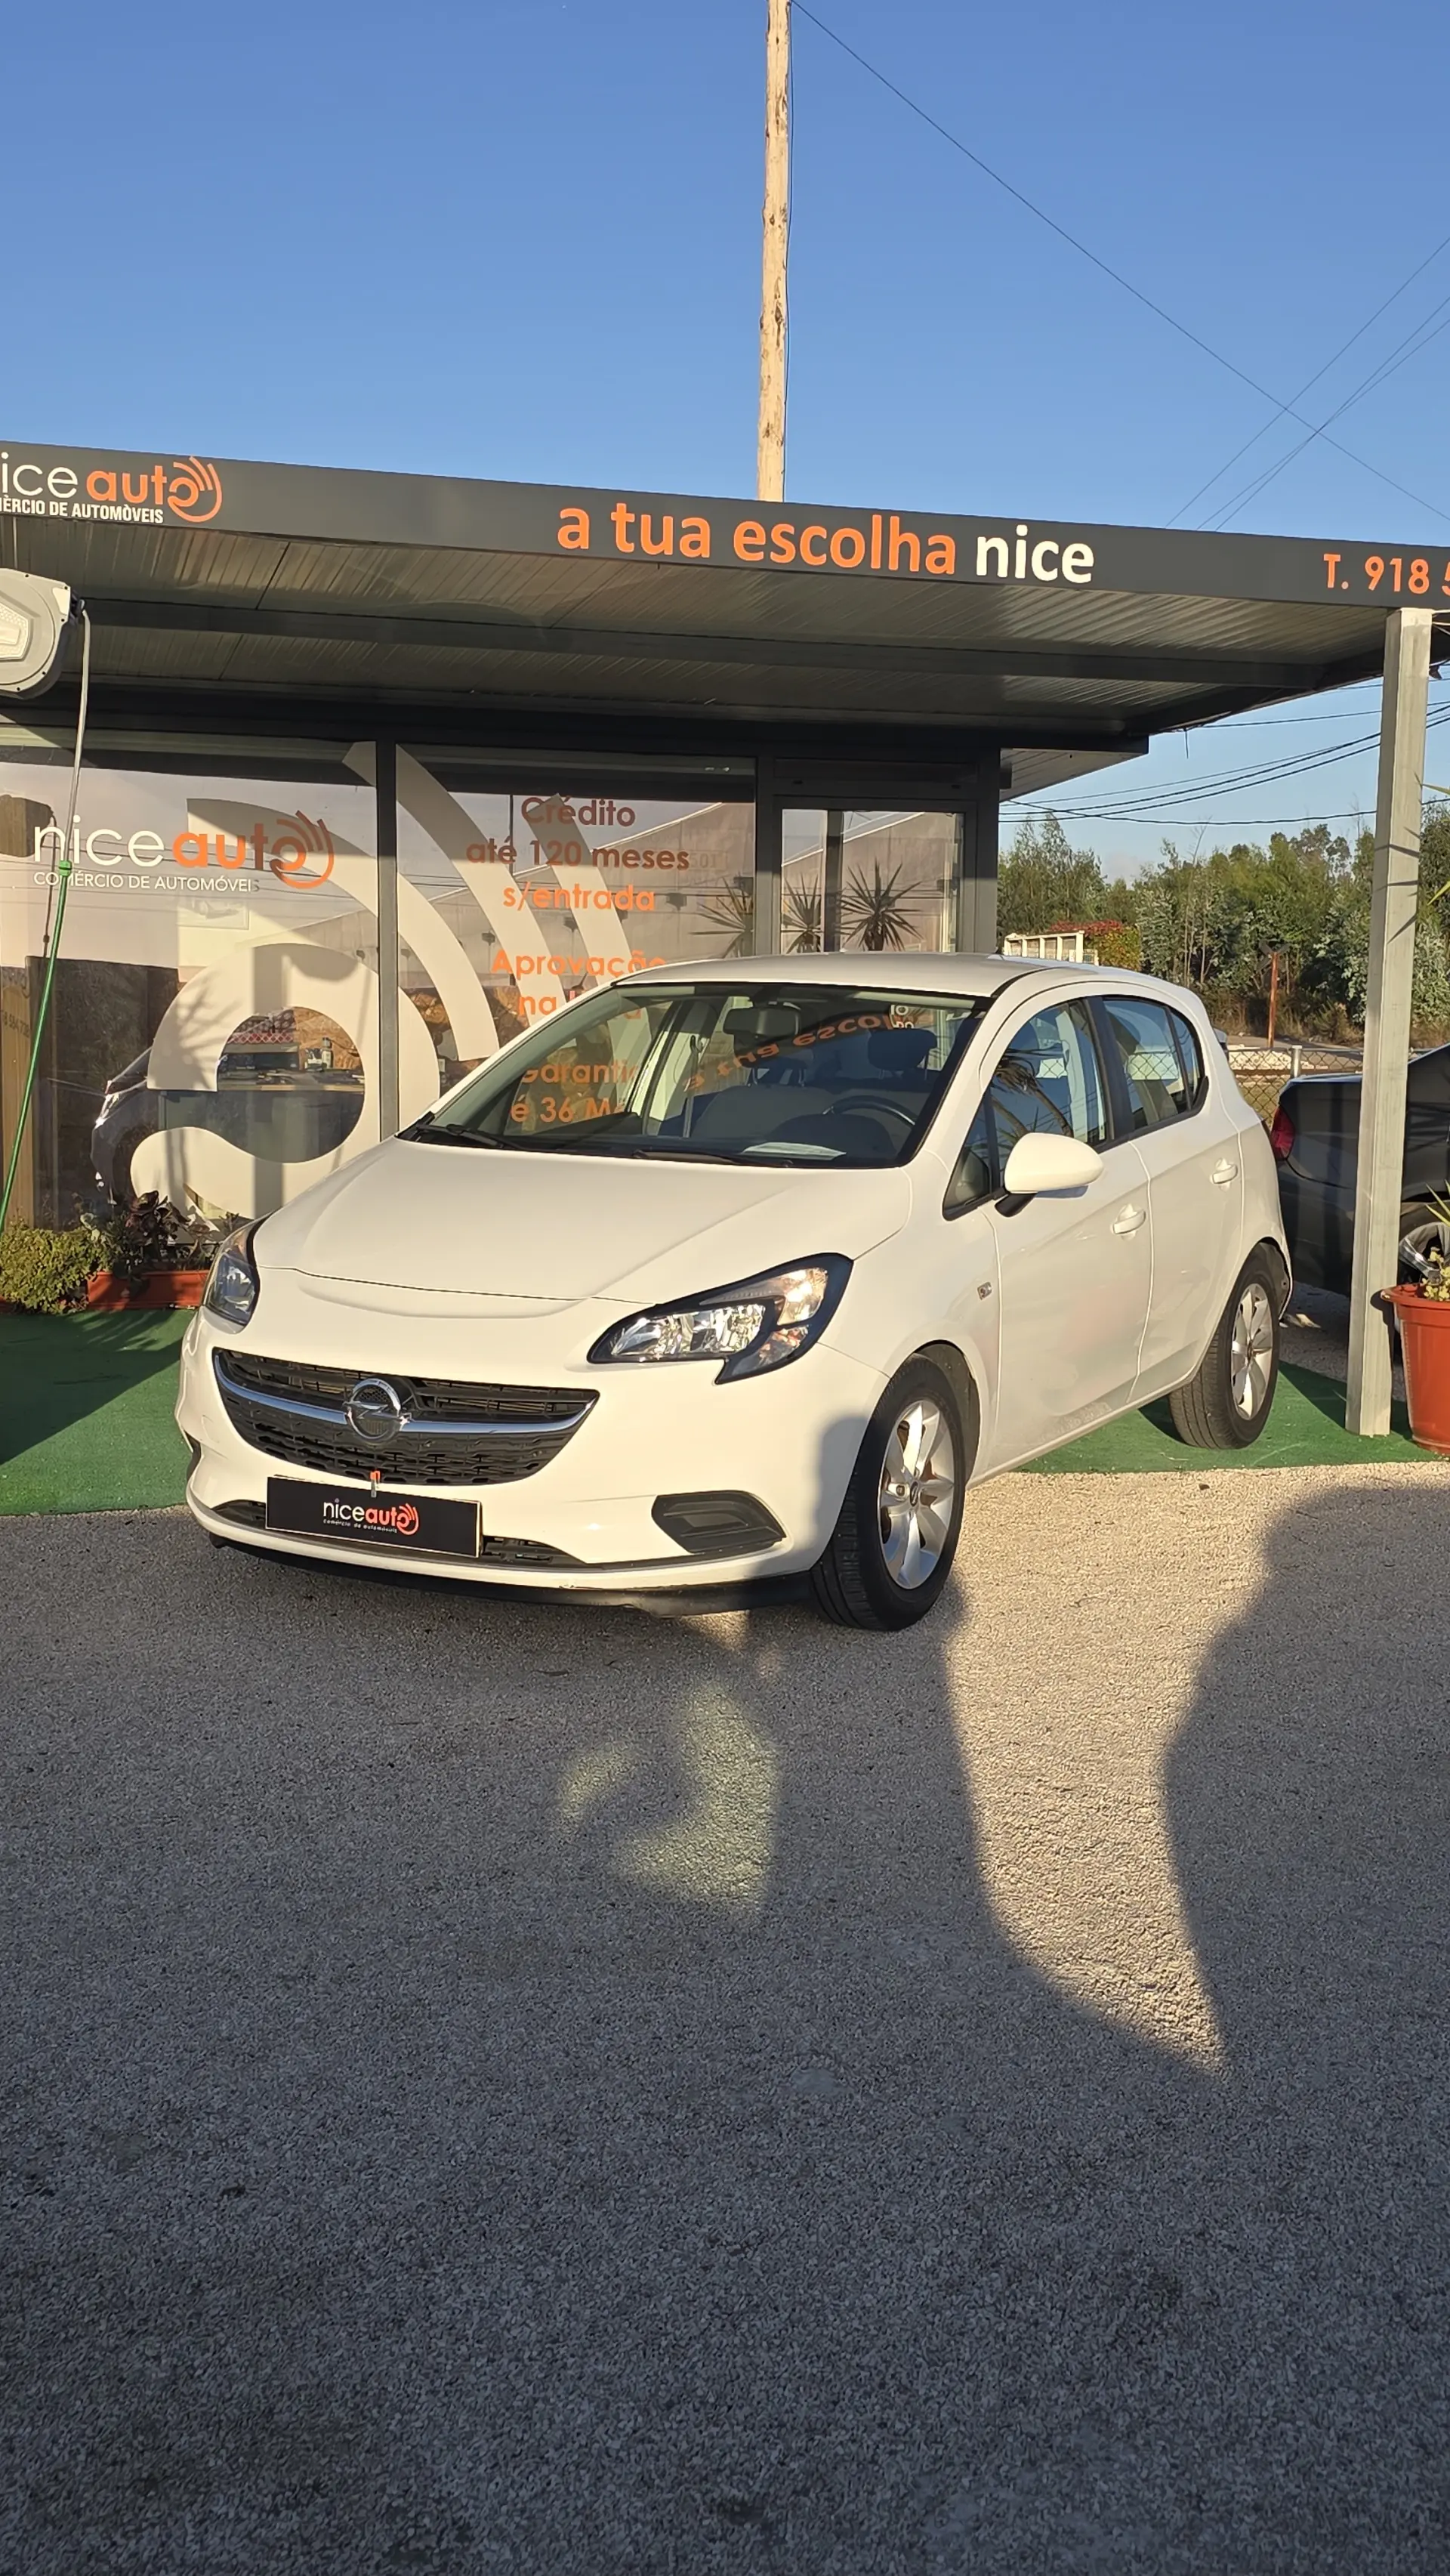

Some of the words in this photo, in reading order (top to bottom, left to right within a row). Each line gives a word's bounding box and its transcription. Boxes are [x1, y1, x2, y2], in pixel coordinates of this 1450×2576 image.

[0, 496, 45, 514] ÈRCIO
[49, 500, 68, 517] DE
[557, 508, 590, 549] a
[611, 502, 711, 558] tua
[733, 514, 956, 575] escolha
[976, 524, 1094, 583] nice
[1323, 553, 1349, 590] T.
[1365, 556, 1430, 595] 918
[521, 795, 636, 827] Crédito
[466, 836, 518, 864] até
[530, 840, 582, 866] 120
[592, 848, 690, 870] meses
[34, 870, 123, 888] COMÉRCIO
[128, 876, 150, 888] DE
[155, 875, 260, 892] AUTOMÓVEIS
[503, 881, 656, 911] s/entrada
[519, 995, 557, 1016] na
[539, 1097, 574, 1123] 36
